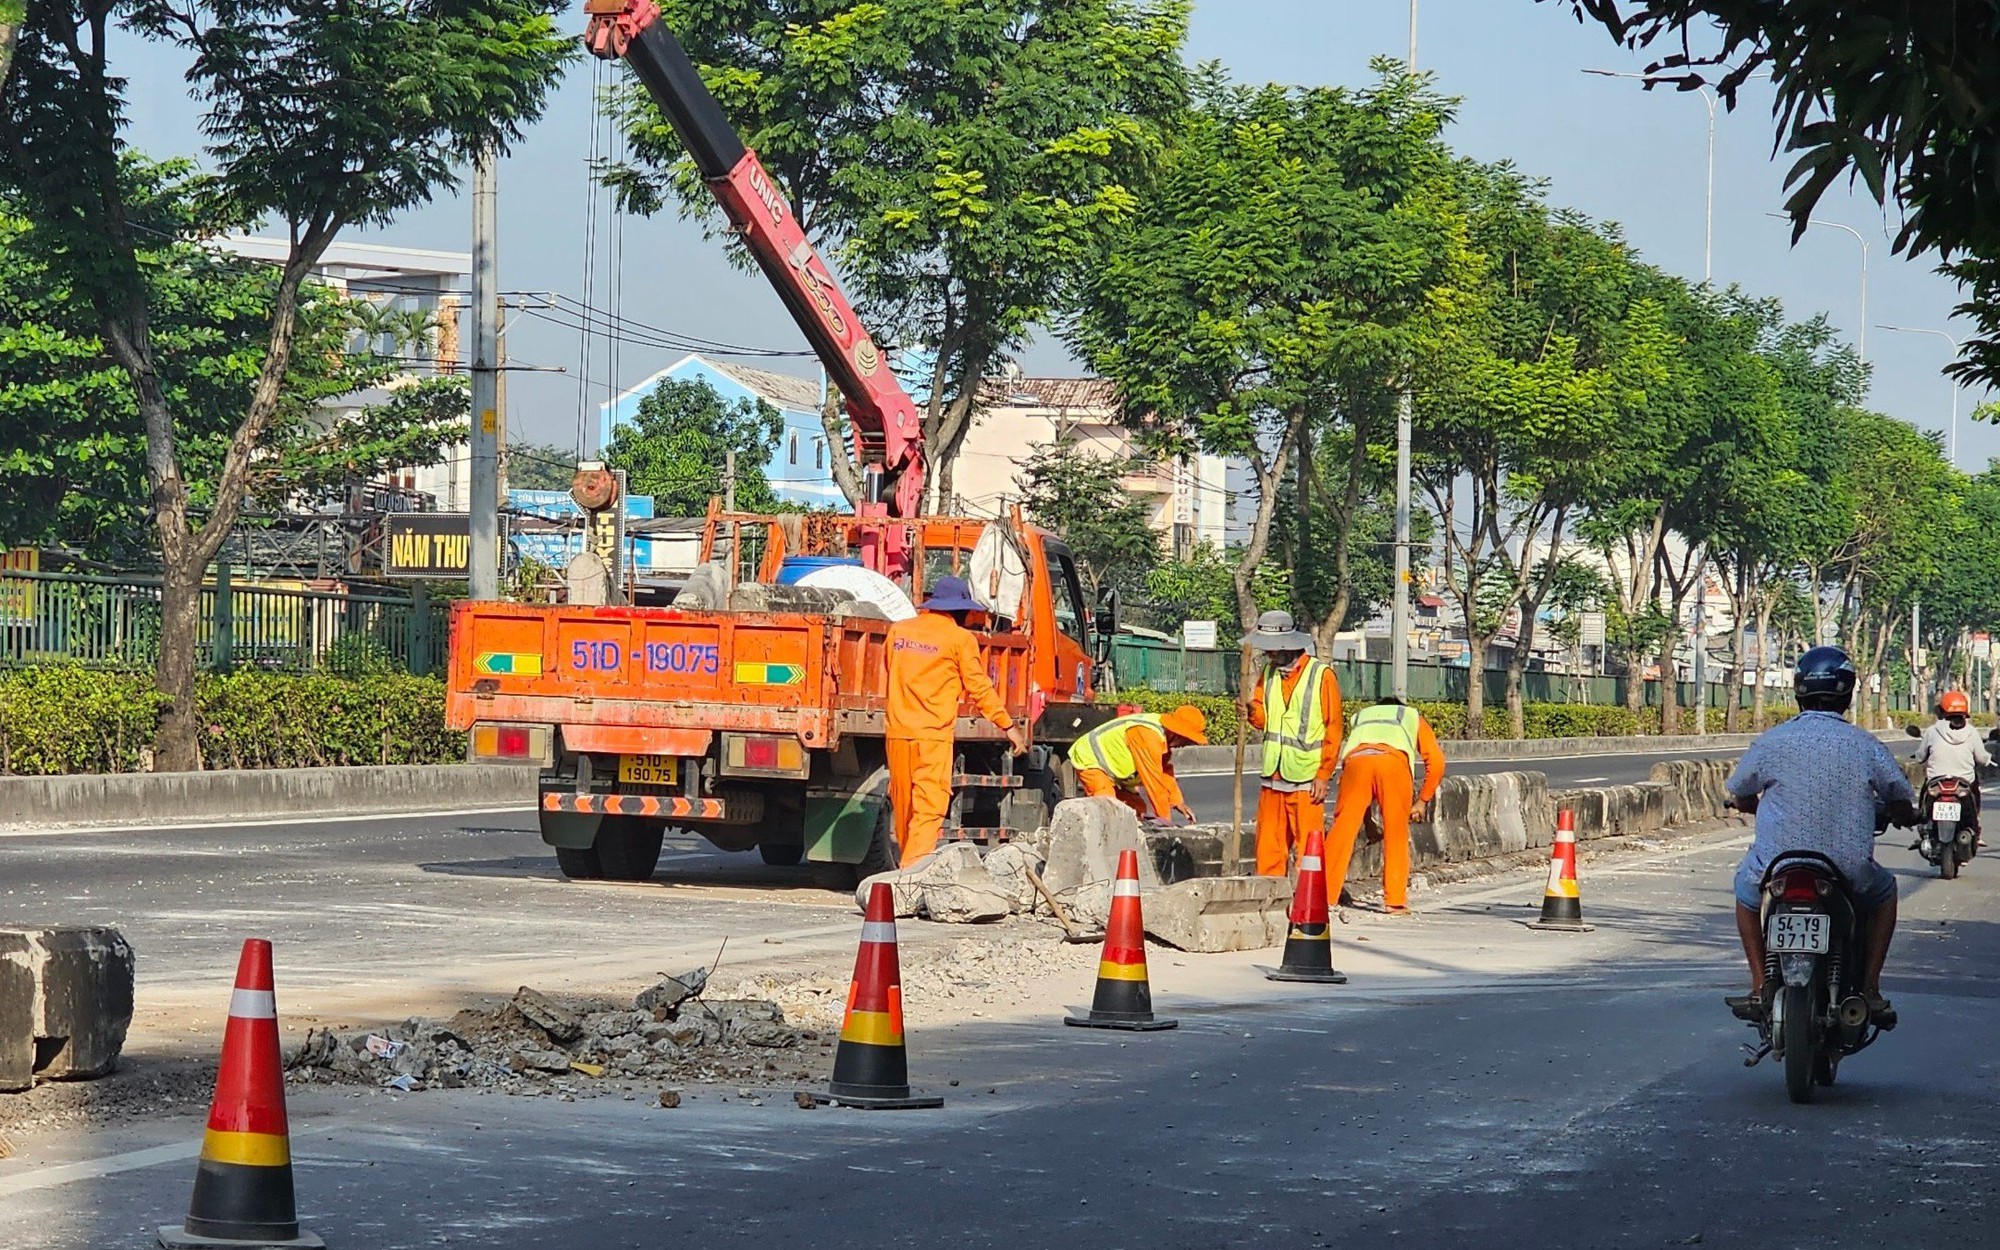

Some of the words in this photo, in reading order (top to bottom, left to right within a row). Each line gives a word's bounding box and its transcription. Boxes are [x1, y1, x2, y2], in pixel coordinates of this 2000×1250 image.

[750, 165, 783, 224] UNIC
[392, 528, 430, 568] NĂM
[573, 641, 620, 671] 51D
[646, 643, 719, 674] 190.75
[636, 755, 661, 768] 51D
[626, 767, 672, 782] 190.75
[1777, 916, 1820, 932] 54-Y9
[1776, 933, 1820, 949] 9715
